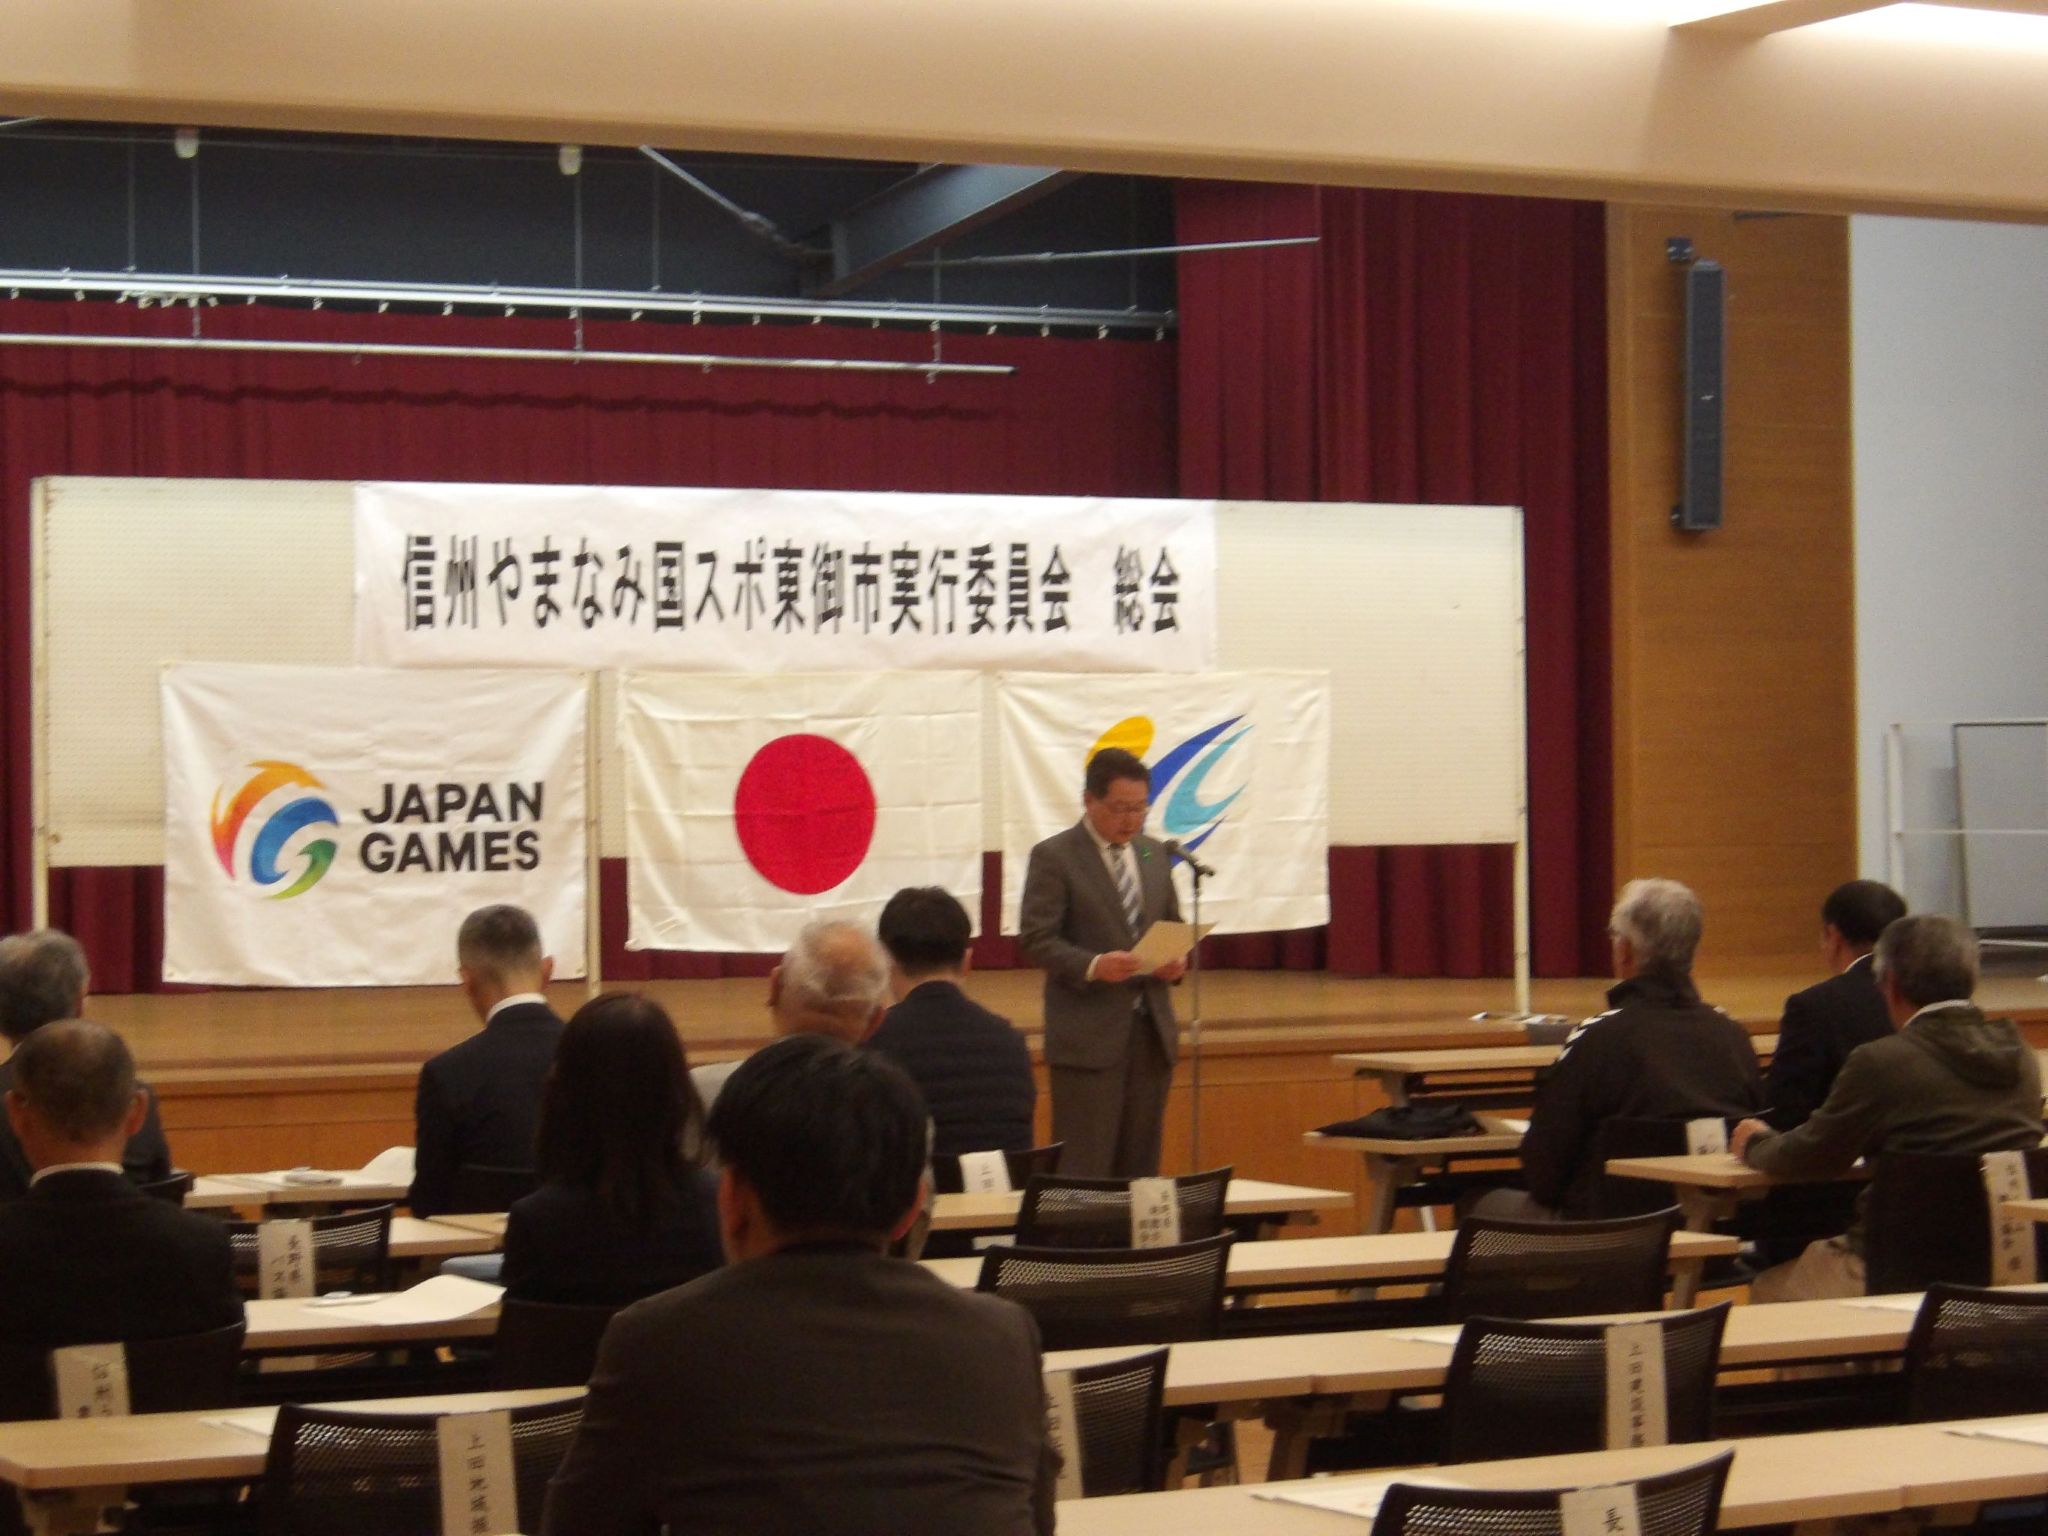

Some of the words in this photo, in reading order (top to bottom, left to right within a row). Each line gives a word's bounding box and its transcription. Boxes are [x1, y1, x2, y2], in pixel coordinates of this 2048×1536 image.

[401, 534, 1072, 634] 信州やまなみ国スポ東御市実行委員会
[1114, 543, 1180, 635] 総会
[361, 781, 544, 824] JAPAN
[360, 830, 539, 873] GAMES
